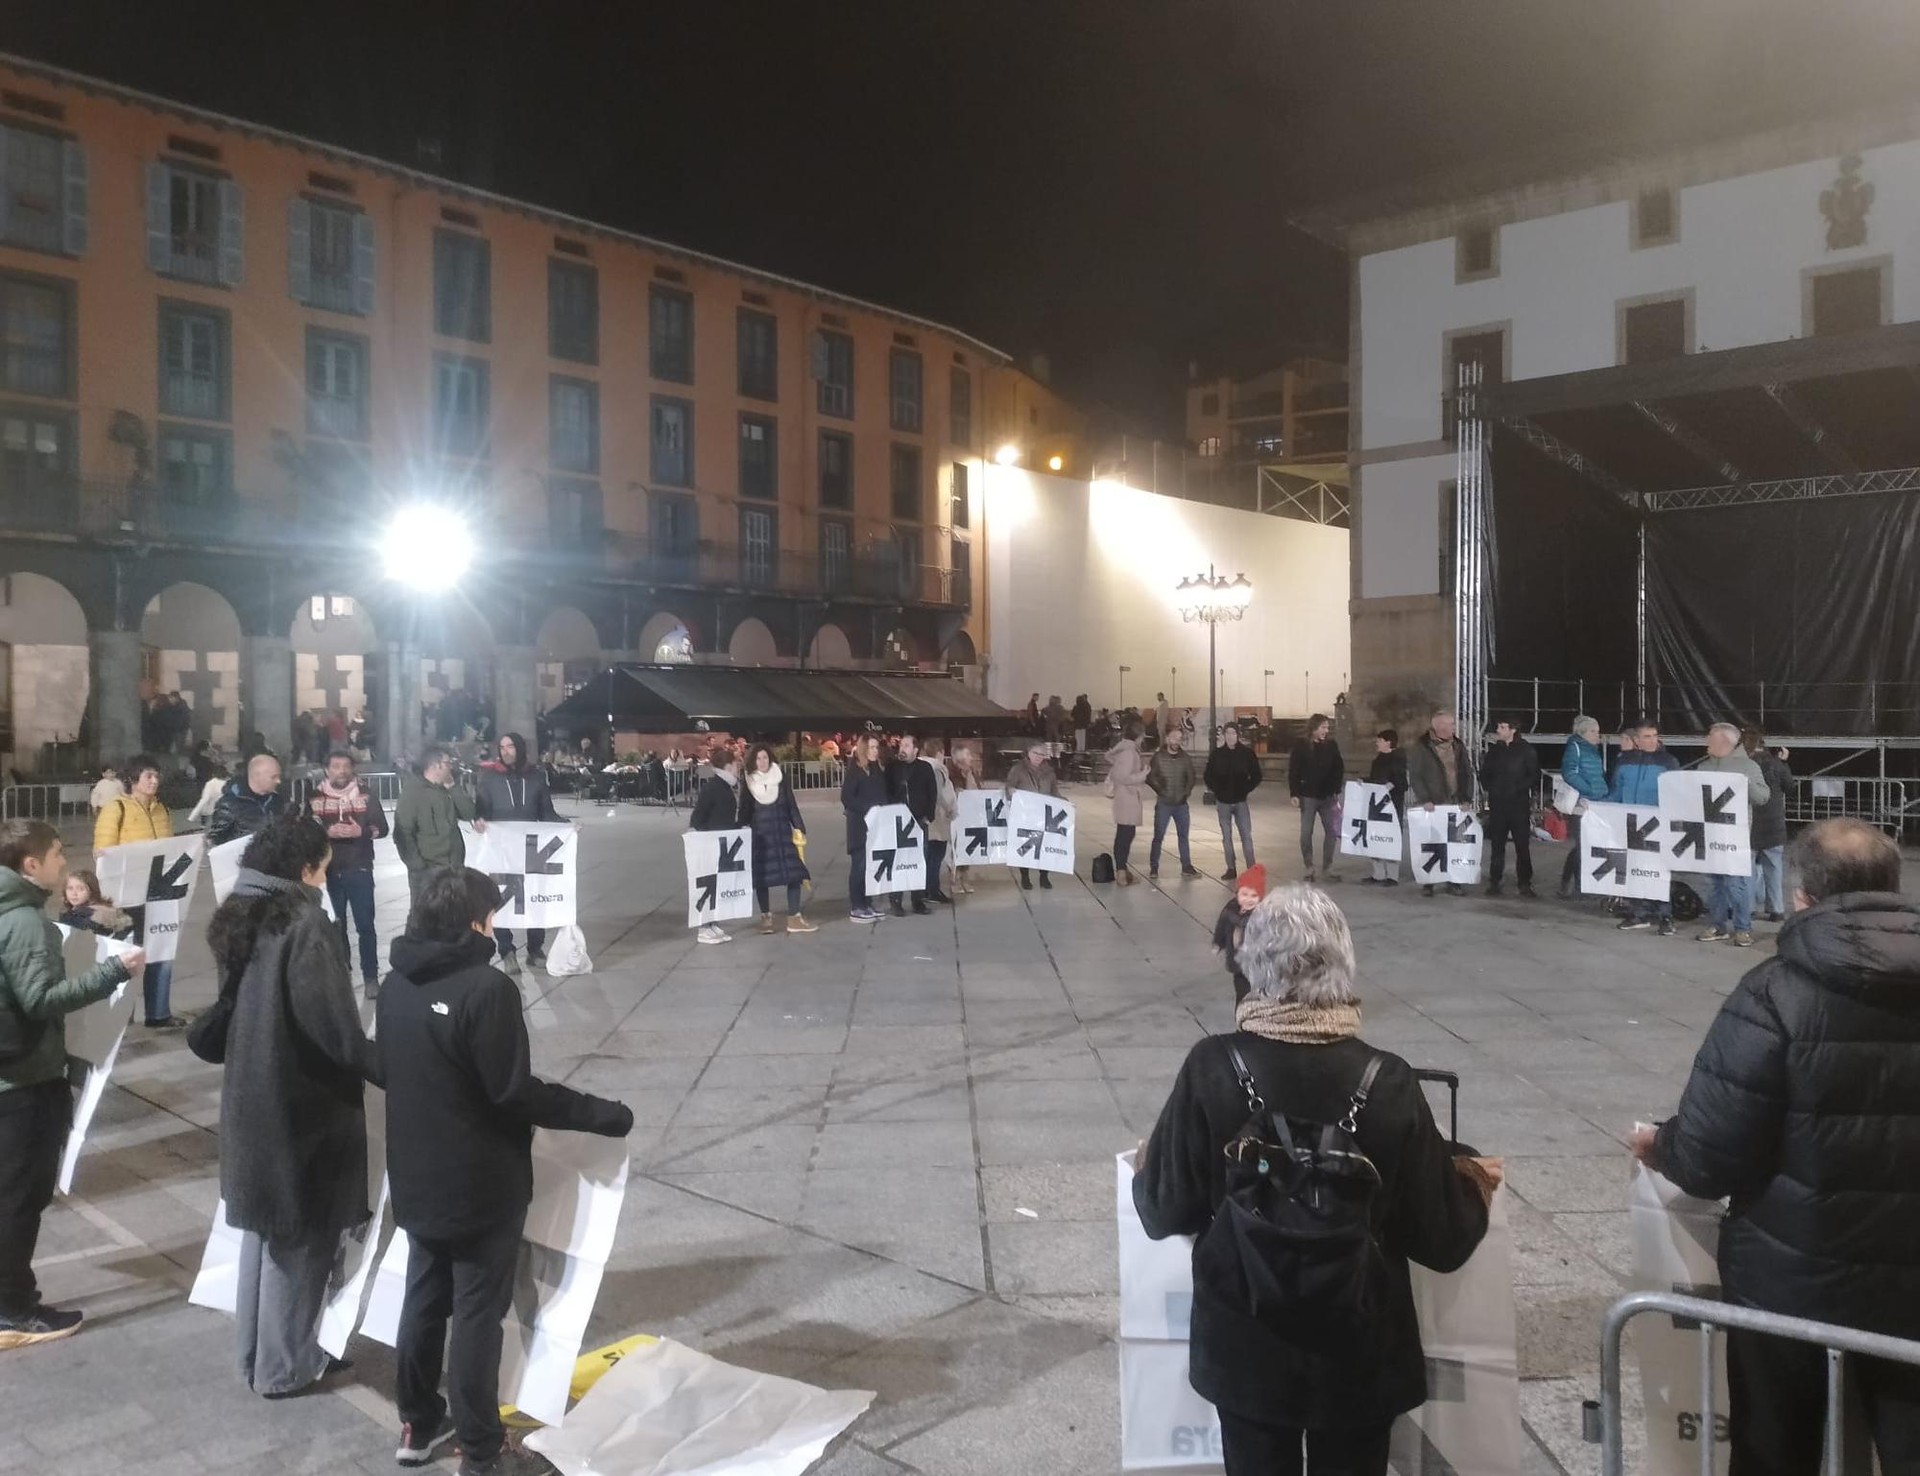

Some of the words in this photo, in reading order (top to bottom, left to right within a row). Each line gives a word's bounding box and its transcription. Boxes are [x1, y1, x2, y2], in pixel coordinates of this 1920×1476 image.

[1708, 840, 1738, 853] etxera
[1450, 856, 1476, 866] etra
[1630, 867, 1661, 880] etxera
[530, 892, 564, 904] etxera
[720, 888, 747, 899] etxera
